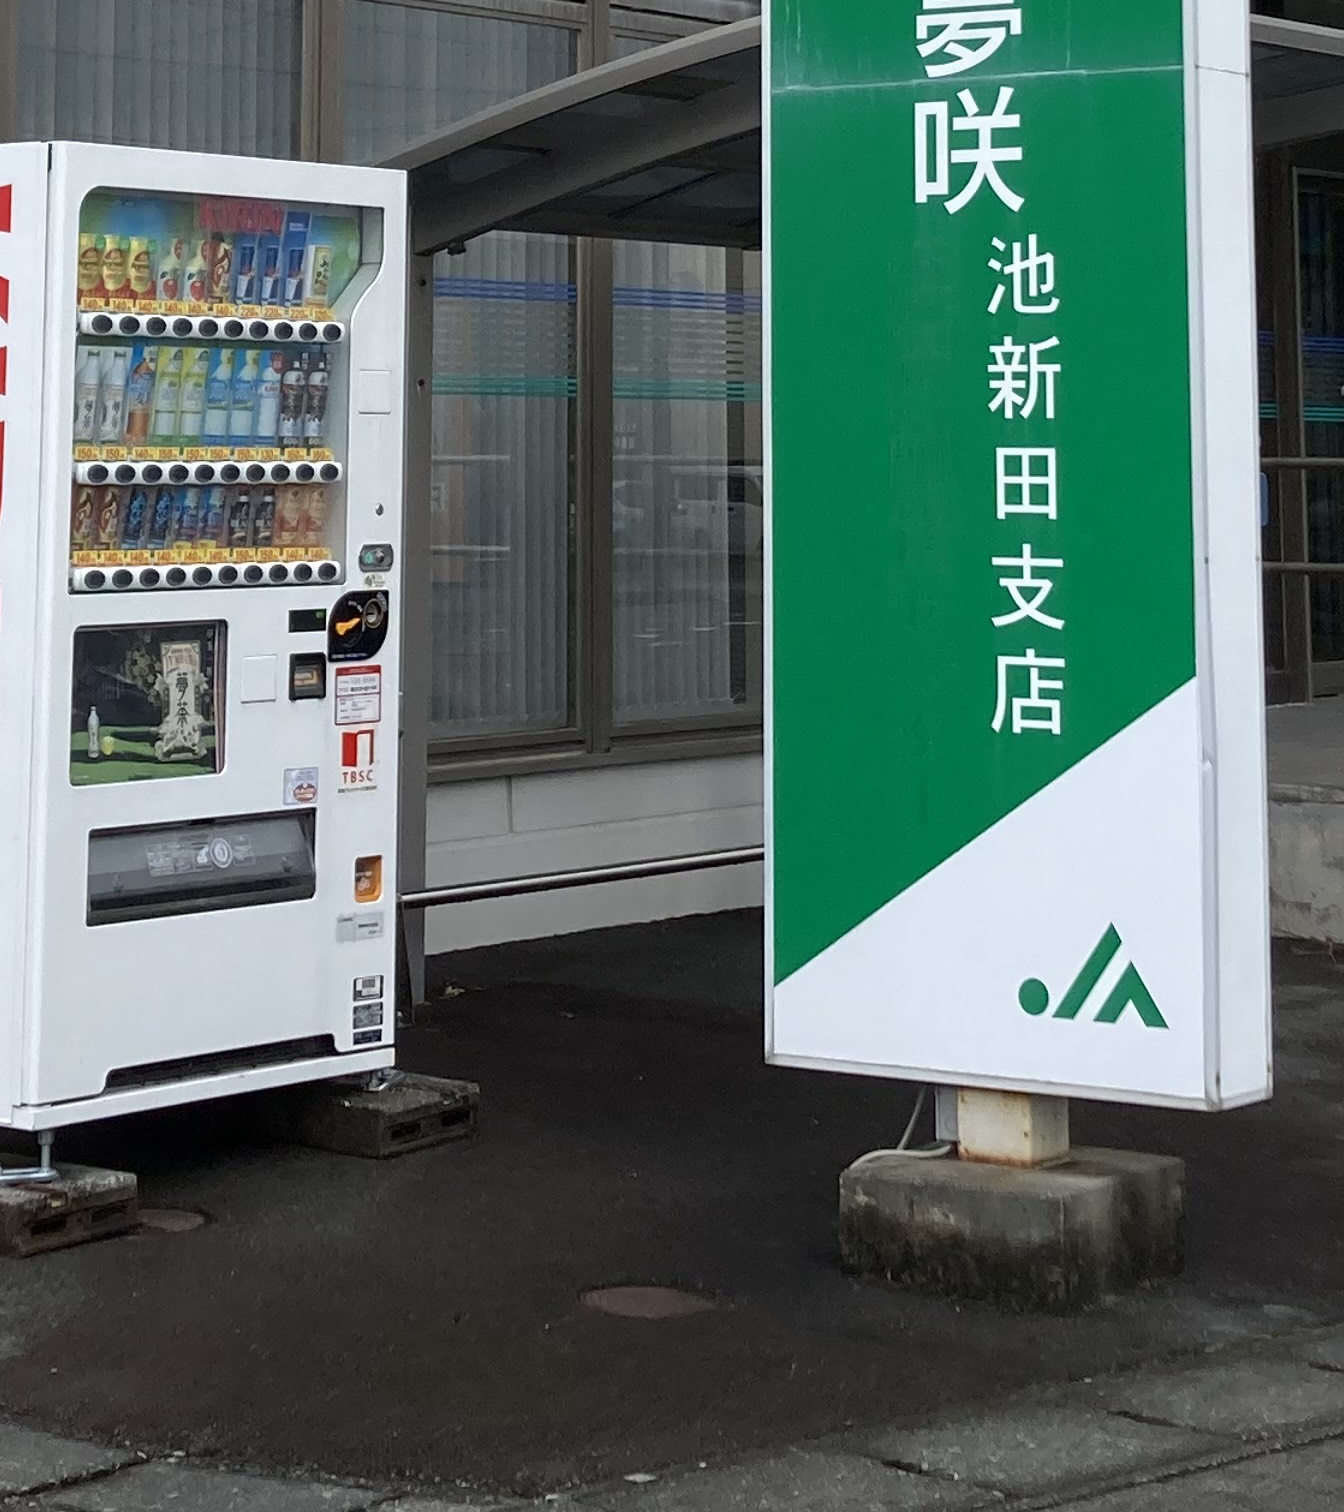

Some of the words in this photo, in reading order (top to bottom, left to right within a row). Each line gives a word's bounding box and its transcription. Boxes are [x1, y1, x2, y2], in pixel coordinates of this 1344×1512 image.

[986, 234, 1066, 736] 池新田支店
[175, 671, 190, 730] 夢茶
[341, 769, 374, 785] TBSC
